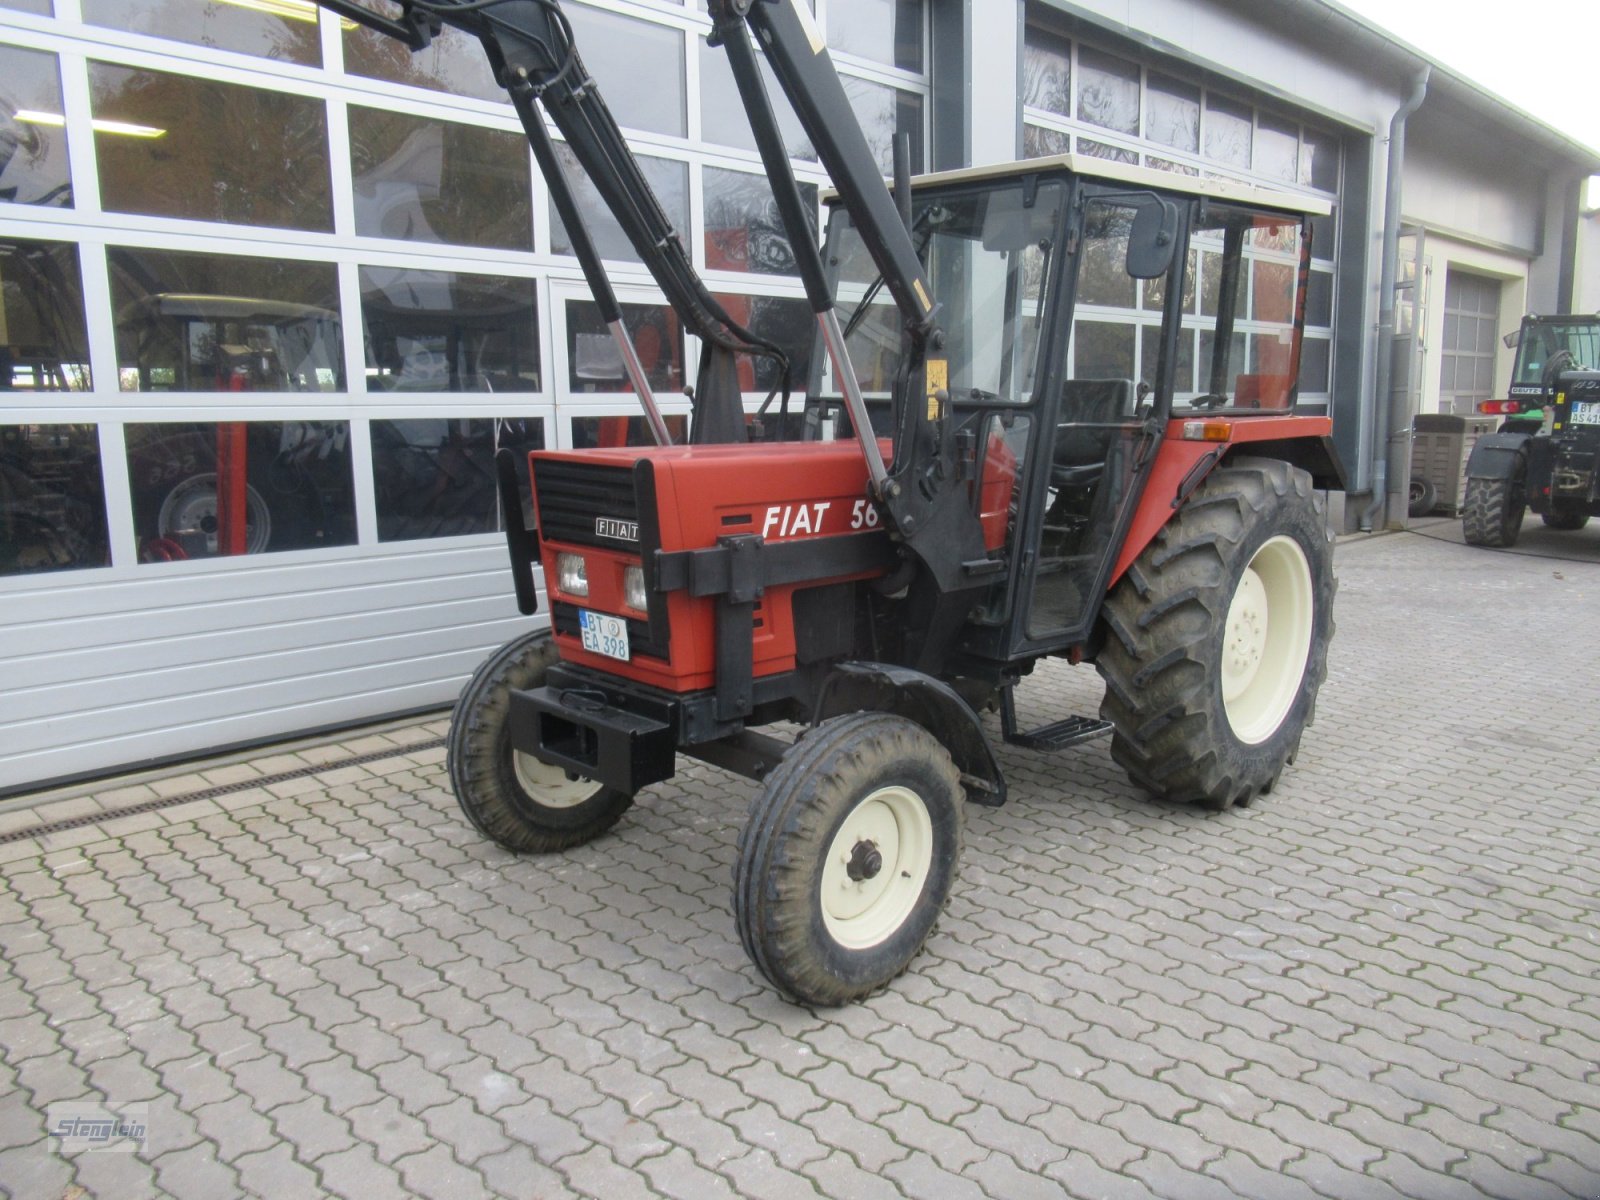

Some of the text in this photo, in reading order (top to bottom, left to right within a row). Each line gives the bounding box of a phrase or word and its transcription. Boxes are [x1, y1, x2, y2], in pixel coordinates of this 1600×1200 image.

[1580, 403, 1593, 413] BT
[1572, 413, 1585, 423] AS
[598, 521, 639, 538] FIAT
[762, 502, 831, 538] FIAT
[587, 613, 603, 634] BT
[584, 630, 626, 658] EA 398
